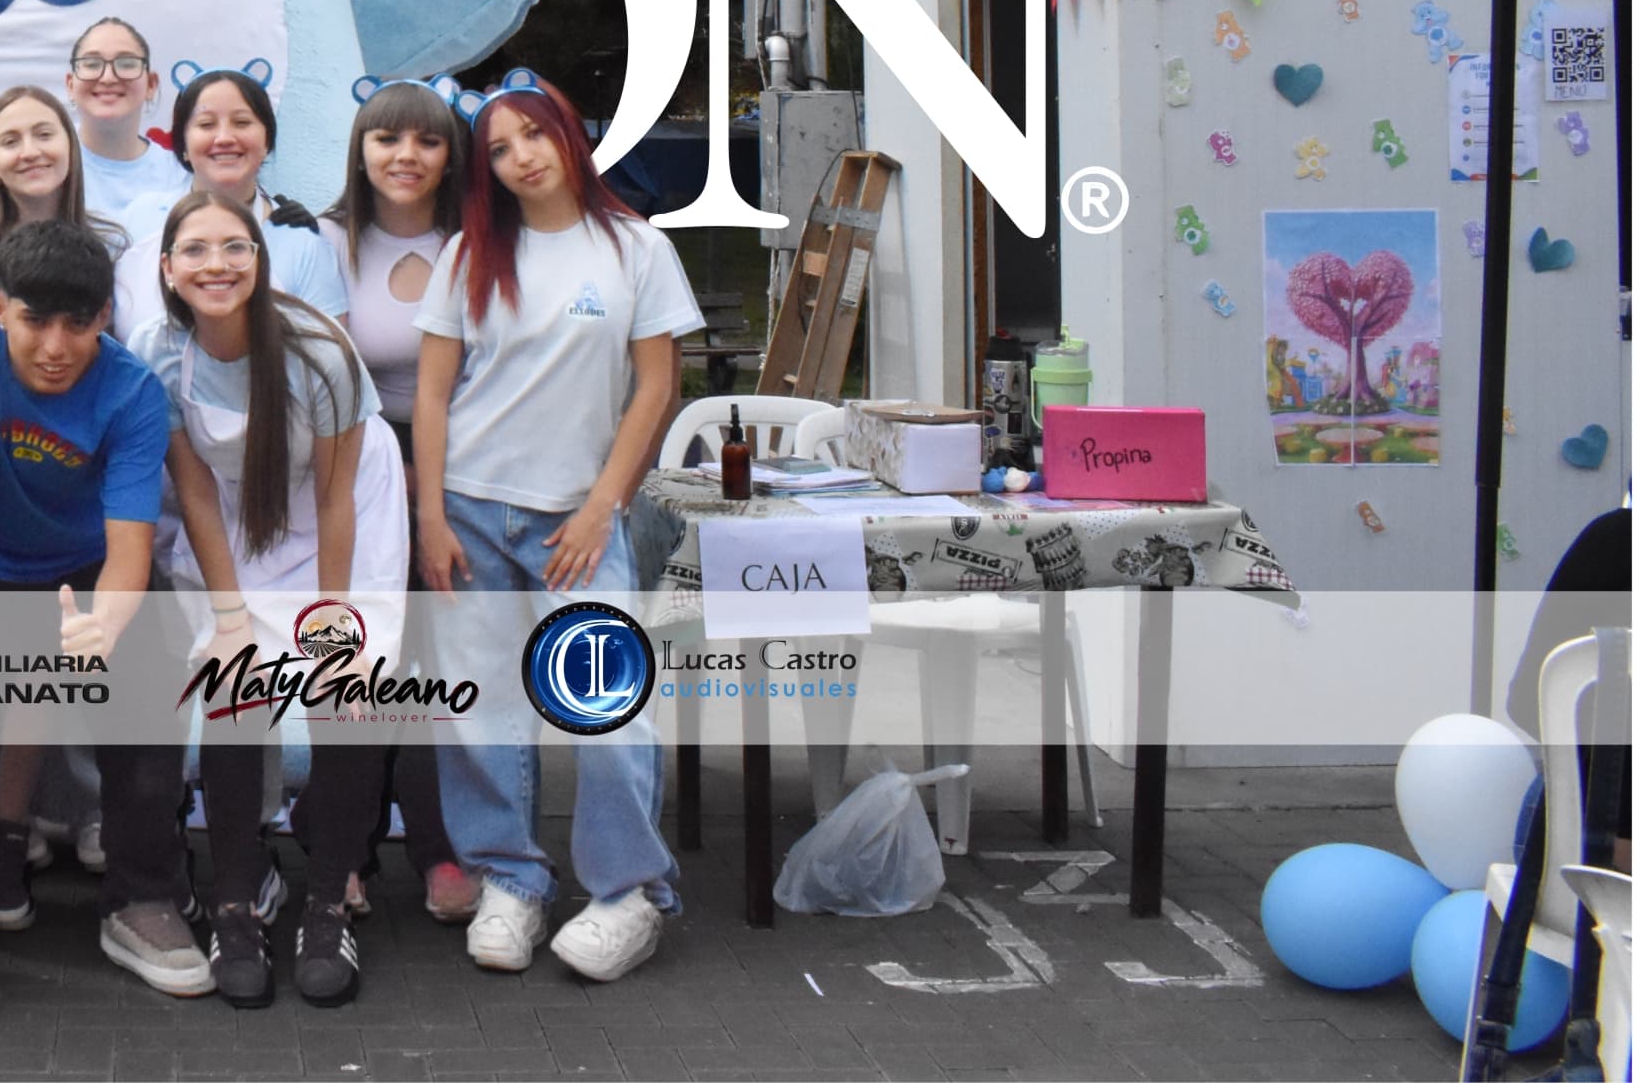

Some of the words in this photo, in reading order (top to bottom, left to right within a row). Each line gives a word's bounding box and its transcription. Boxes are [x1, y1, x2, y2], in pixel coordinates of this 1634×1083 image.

[1079, 437, 1153, 473] Propina
[946, 545, 1002, 570] PIZZA
[1235, 536, 1276, 560] ZZA
[741, 562, 828, 595] CAJA
